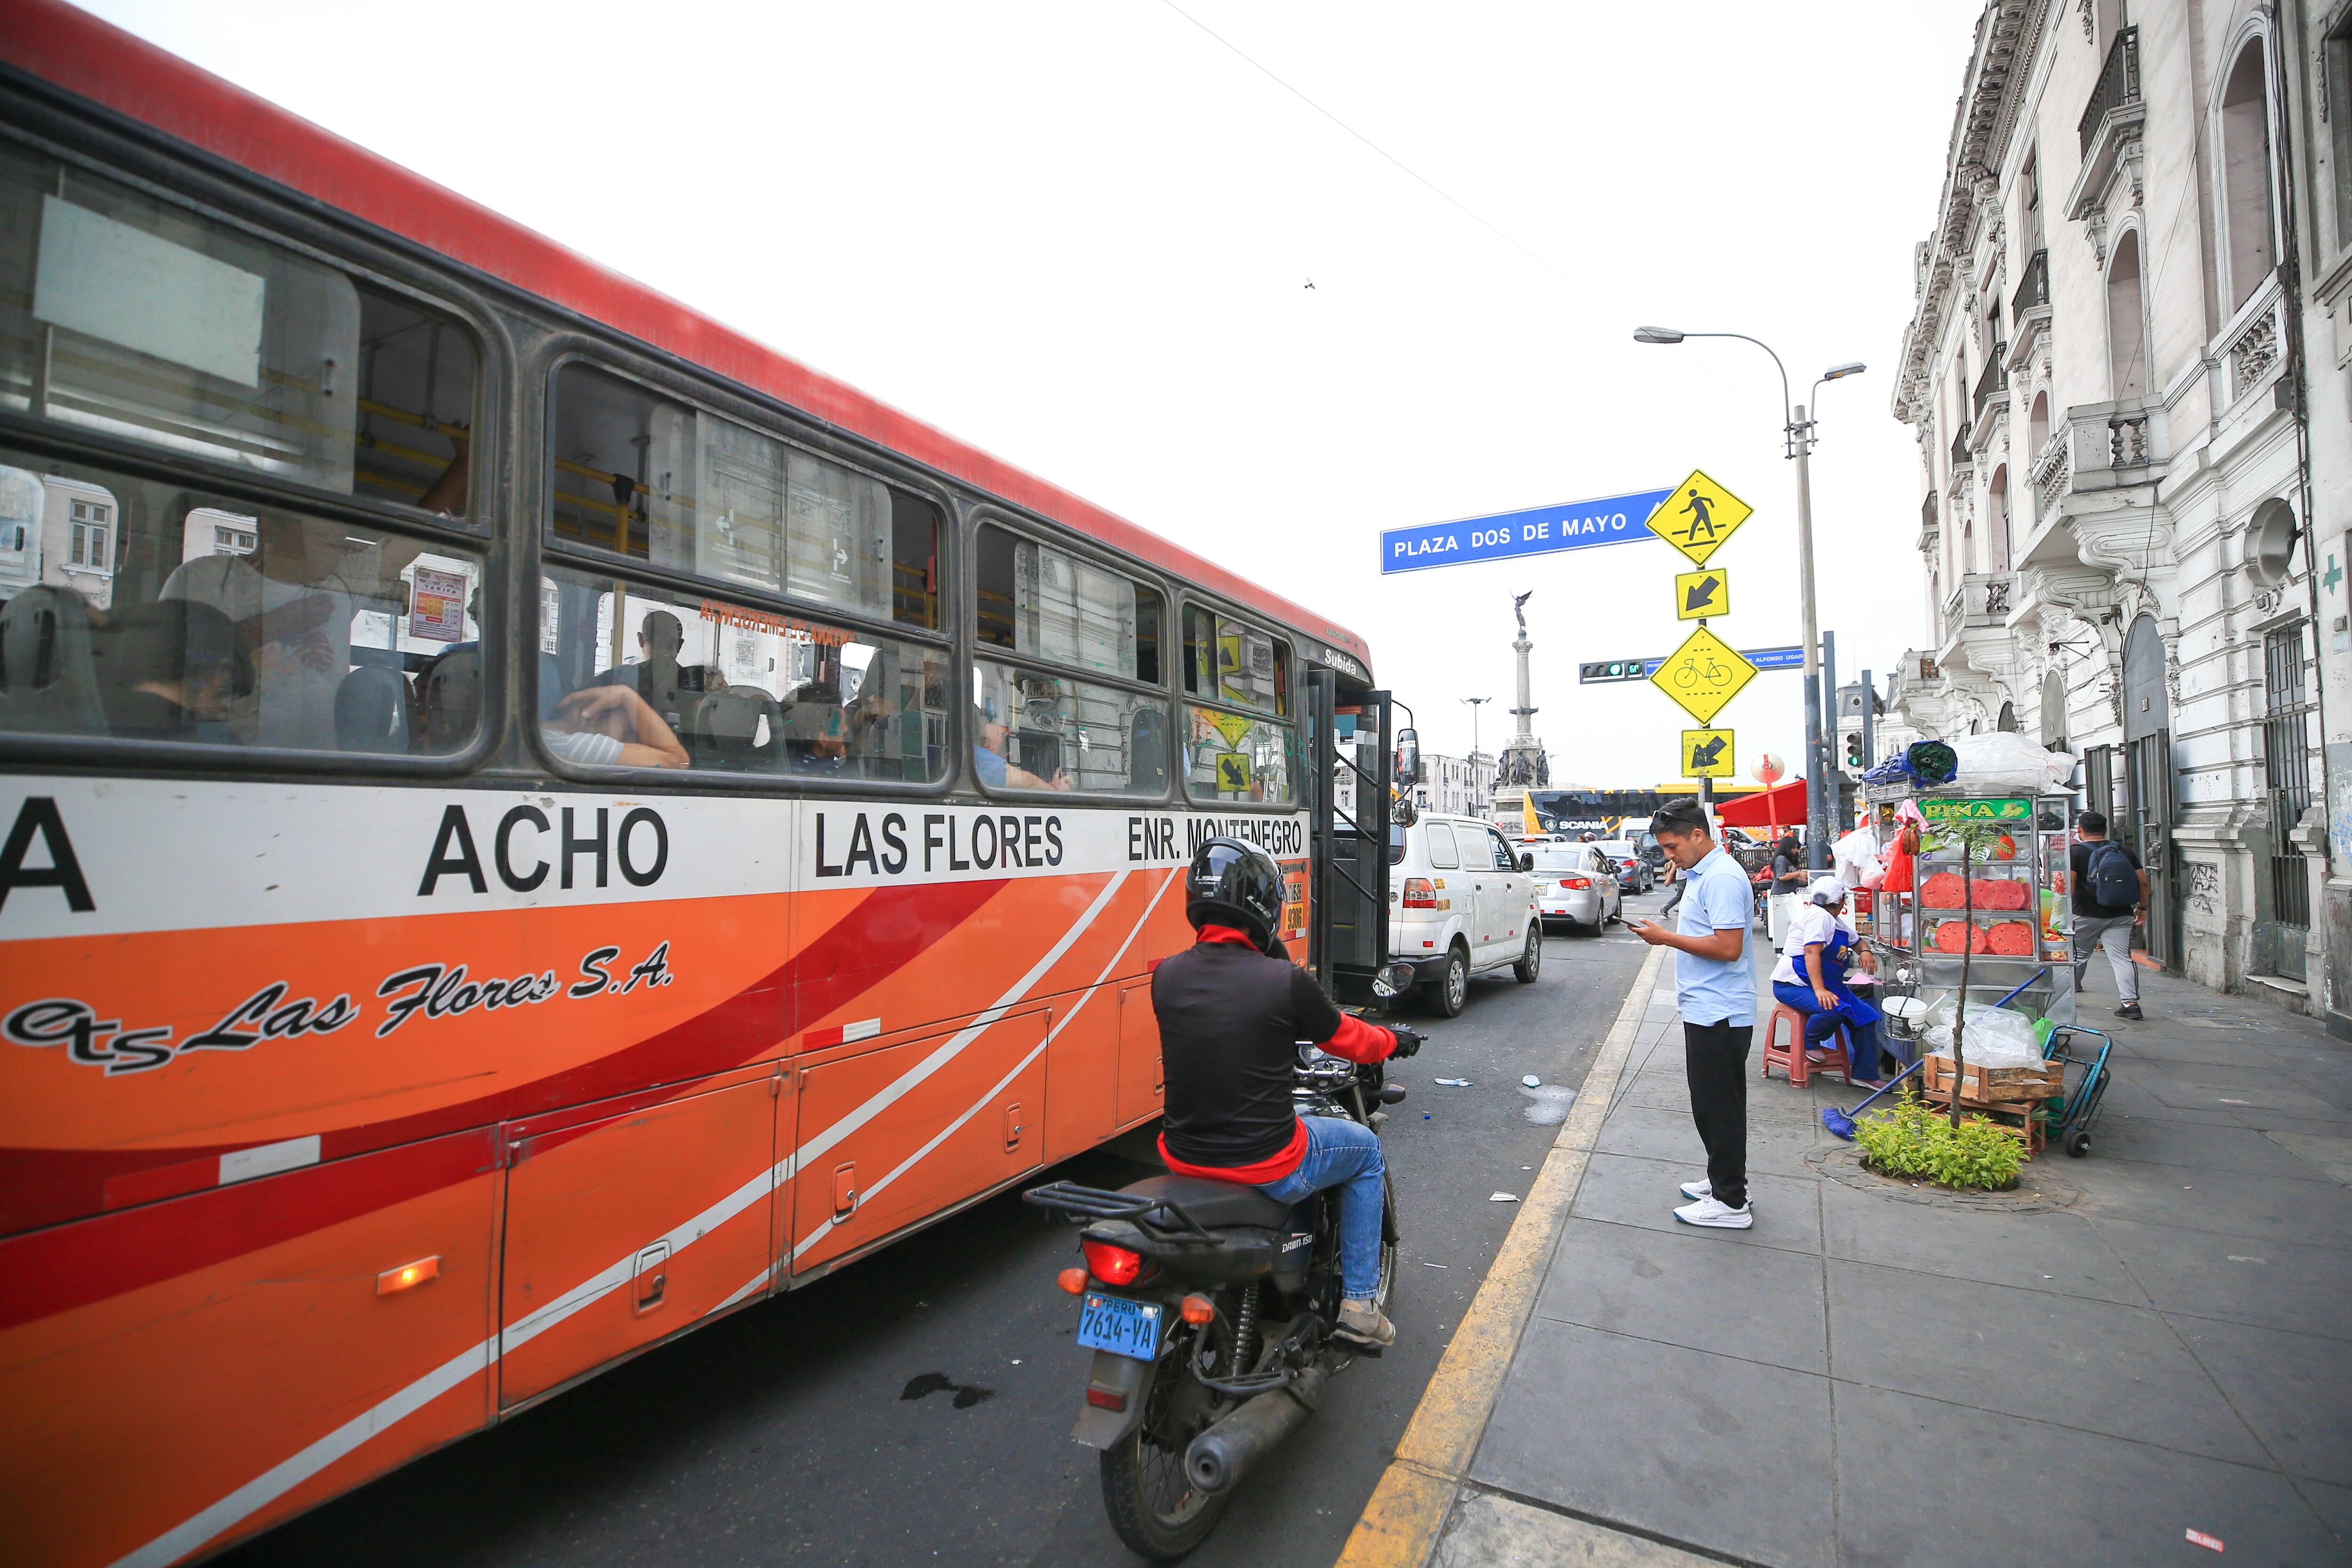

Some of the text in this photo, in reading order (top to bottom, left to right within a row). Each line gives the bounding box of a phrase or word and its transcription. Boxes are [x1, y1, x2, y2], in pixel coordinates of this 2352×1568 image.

[1394, 512, 1627, 557] PLAZA DOS DE MAYO
[424, 584, 456, 594] TARIFA
[1324, 648, 1357, 676] Subida
[1559, 820, 1609, 830] SCANIA
[417, 804, 669, 897] ACHO
[815, 812, 908, 877] LAS
[924, 814, 1063, 872] FLORES
[1128, 817, 1180, 861] ENR.
[1247, 895, 1272, 919] LS2
[1287, 907, 1302, 931] 9306
[178, 980, 361, 1054] Las
[375, 962, 561, 1039] Flores
[568, 941, 674, 1000] S.A.
[1083, 1308, 1152, 1349] 7614-YA
